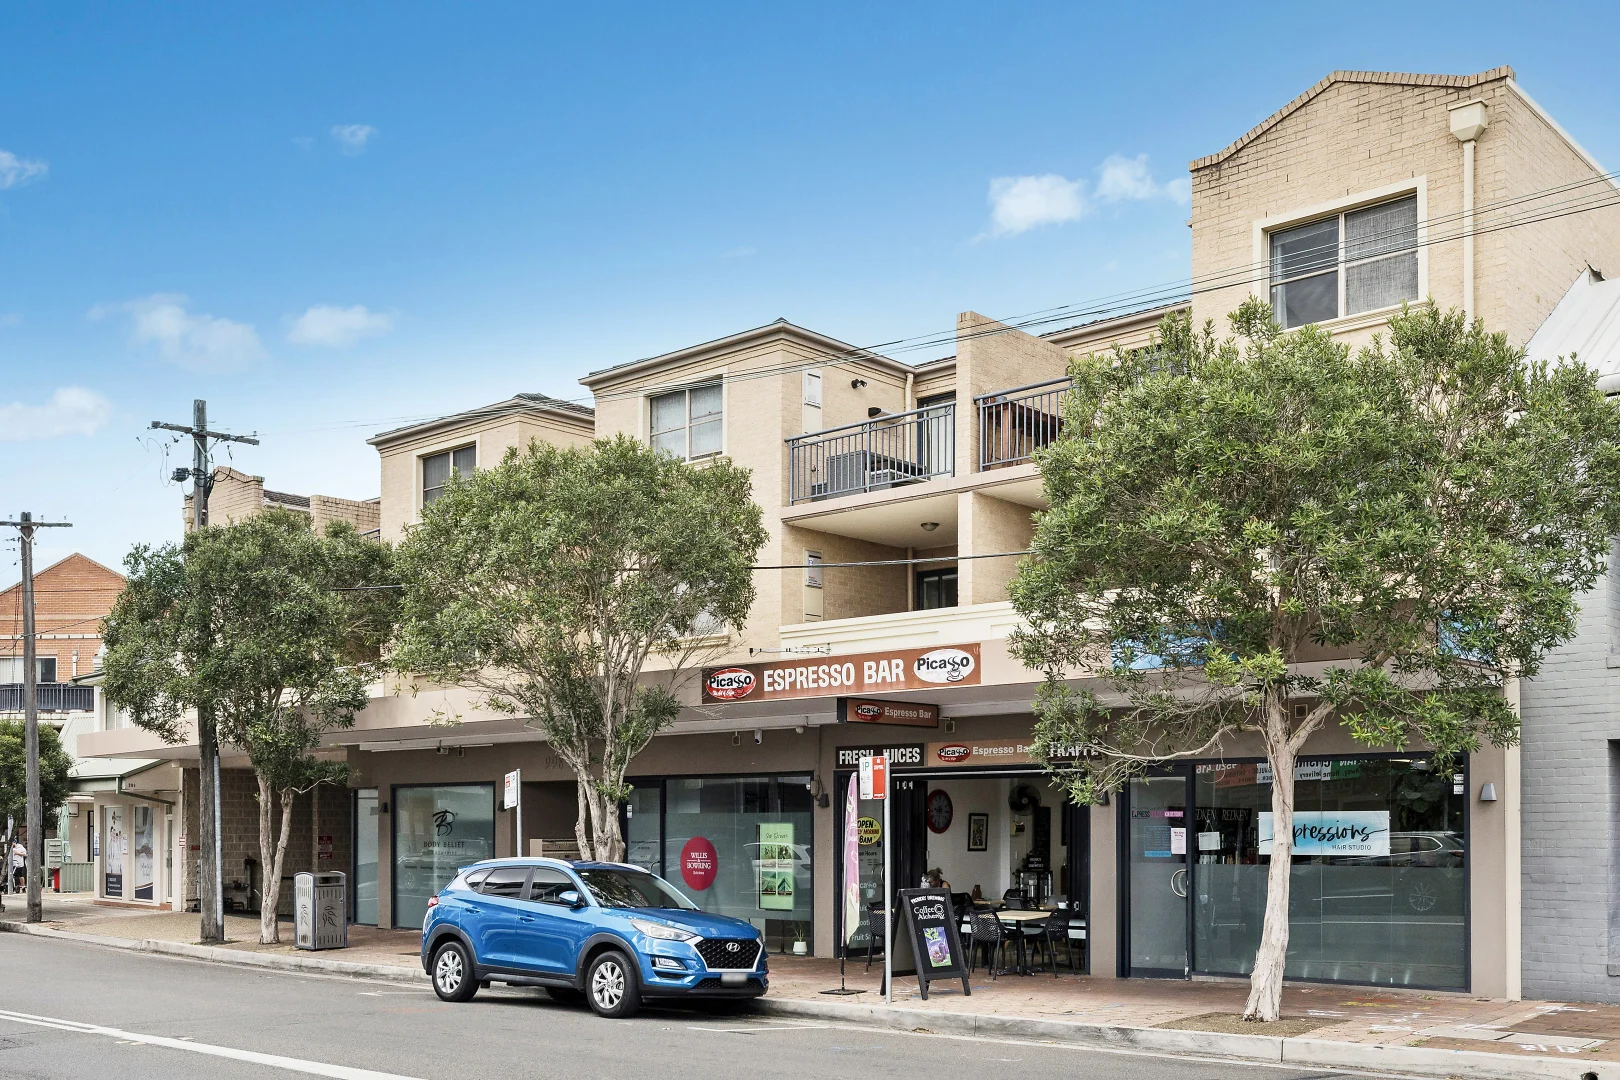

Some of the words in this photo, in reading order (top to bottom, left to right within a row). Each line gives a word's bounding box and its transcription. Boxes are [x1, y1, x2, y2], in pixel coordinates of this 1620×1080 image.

[915, 655, 971, 672] Picasso
[708, 674, 753, 689] Picasso
[763, 661, 856, 692] ESPRESSO
[863, 658, 906, 685] BAR
[856, 705, 881, 716] Picasso
[884, 706, 918, 719] Espresso
[918, 709, 932, 719] Bar
[883, 747, 921, 765] UICES
[972, 745, 1014, 757] Espresso
[1016, 744, 1029, 753] Ba
[857, 820, 874, 829] OPEN
[1292, 820, 1388, 847] pressions
[686, 862, 711, 870] BOWRING
[913, 905, 935, 915] Coffee
